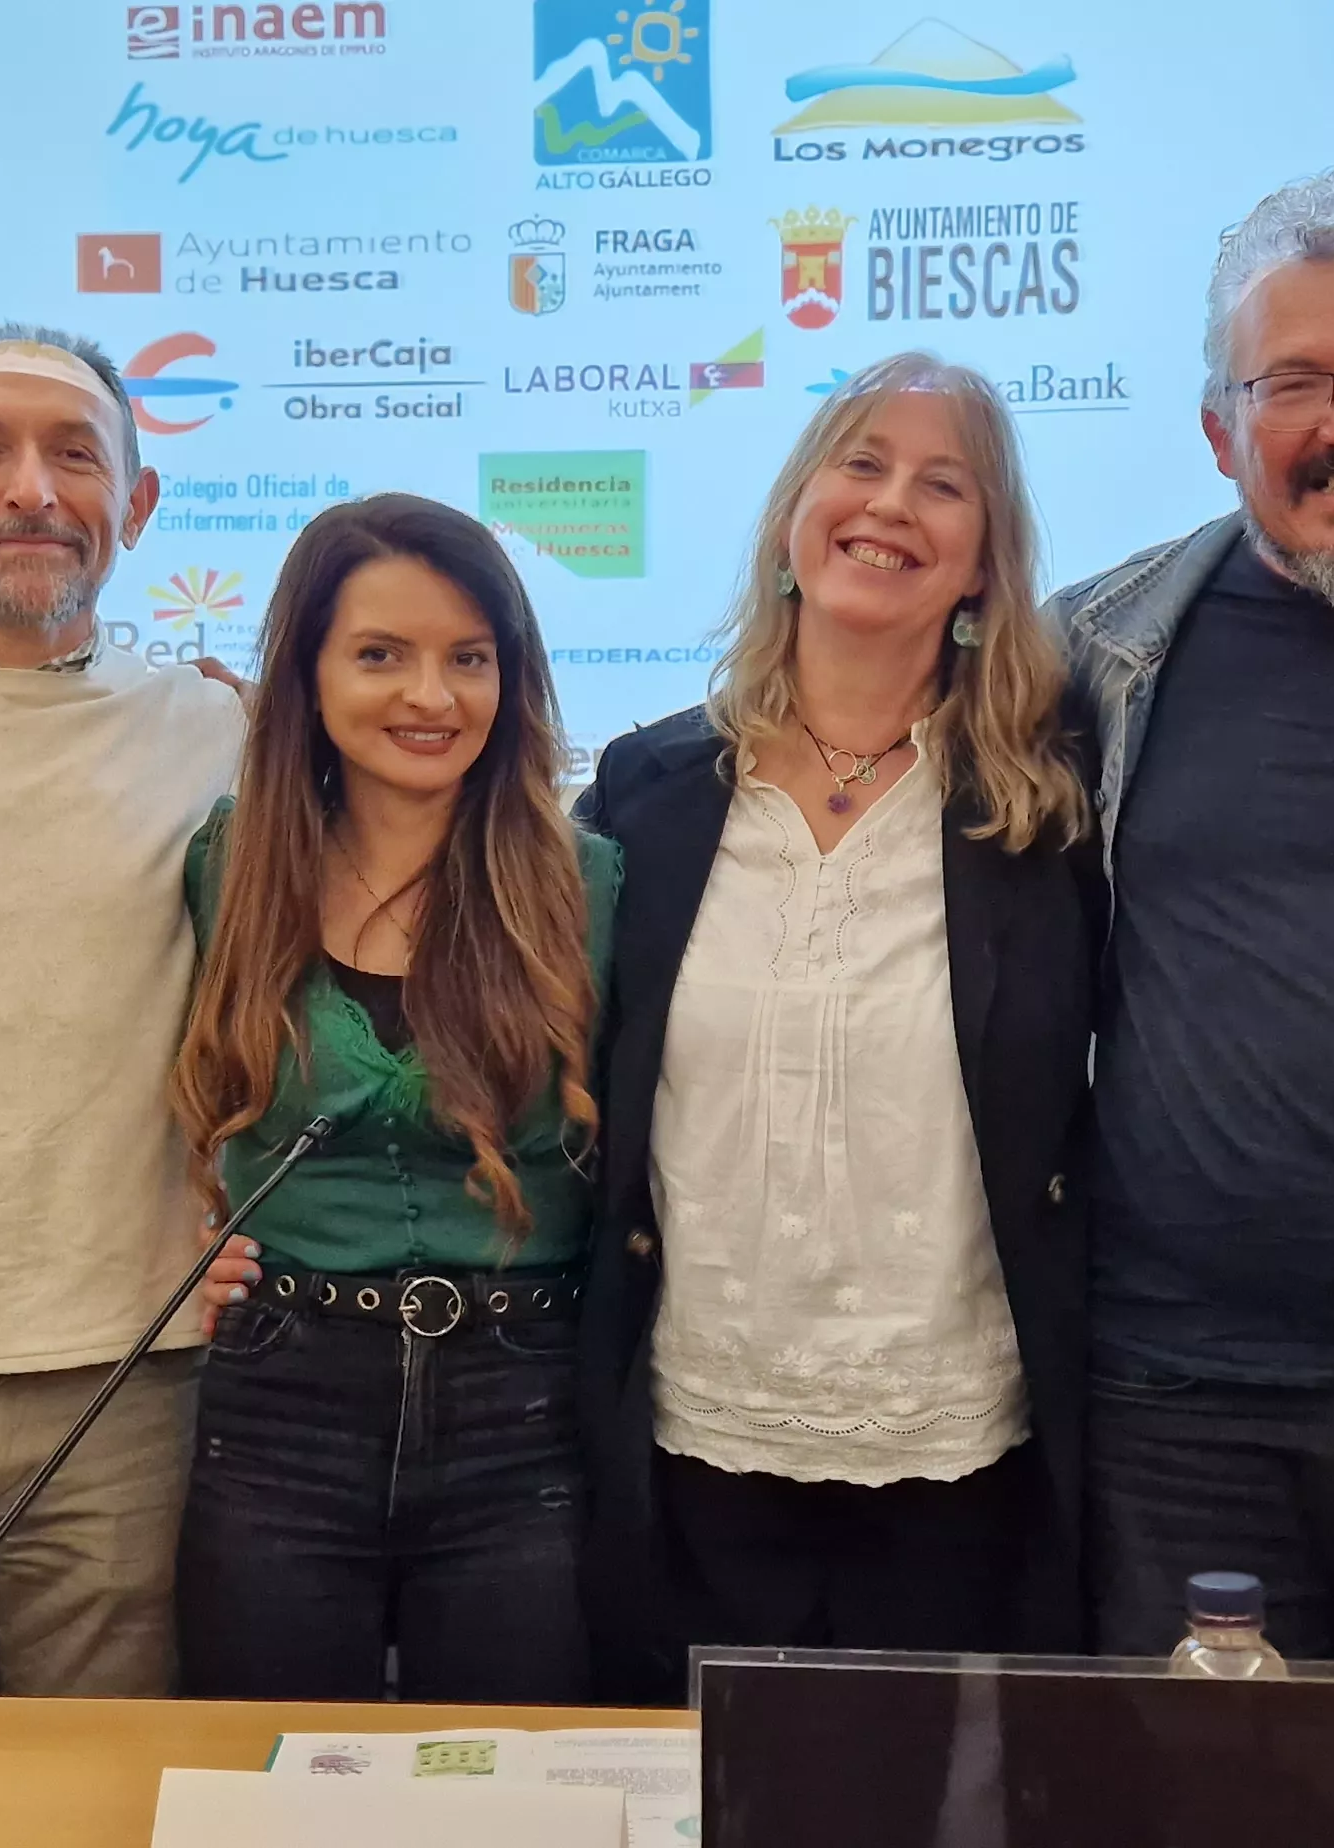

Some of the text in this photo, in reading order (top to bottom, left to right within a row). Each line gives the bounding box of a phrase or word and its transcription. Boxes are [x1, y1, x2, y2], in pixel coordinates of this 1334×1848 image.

[192, 1, 386, 41] inaem
[105, 81, 459, 184] hoya de huesca
[773, 133, 1086, 162] Los Monegros
[535, 167, 712, 191] ALTO GÁLLEGO
[868, 201, 1079, 241] AYUNTAMIENTO DE
[176, 230, 472, 265] Ayuntamiento
[594, 229, 696, 254] FRAGA
[175, 265, 400, 294] de Huesca
[593, 262, 723, 281] Ayuntamiento
[867, 238, 1081, 322] BIESCAS
[593, 283, 701, 301] Ajuntament
[293, 338, 452, 374] iberCaja
[503, 362, 682, 394] LABORAL
[995, 361, 1131, 404] aBank
[283, 392, 463, 420] Obra Social
[608, 397, 682, 419] kutxa
[246, 473, 316, 498] Oficial
[324, 472, 350, 497] de
[491, 476, 631, 494] Residencia
[536, 541, 631, 557] Huesca
